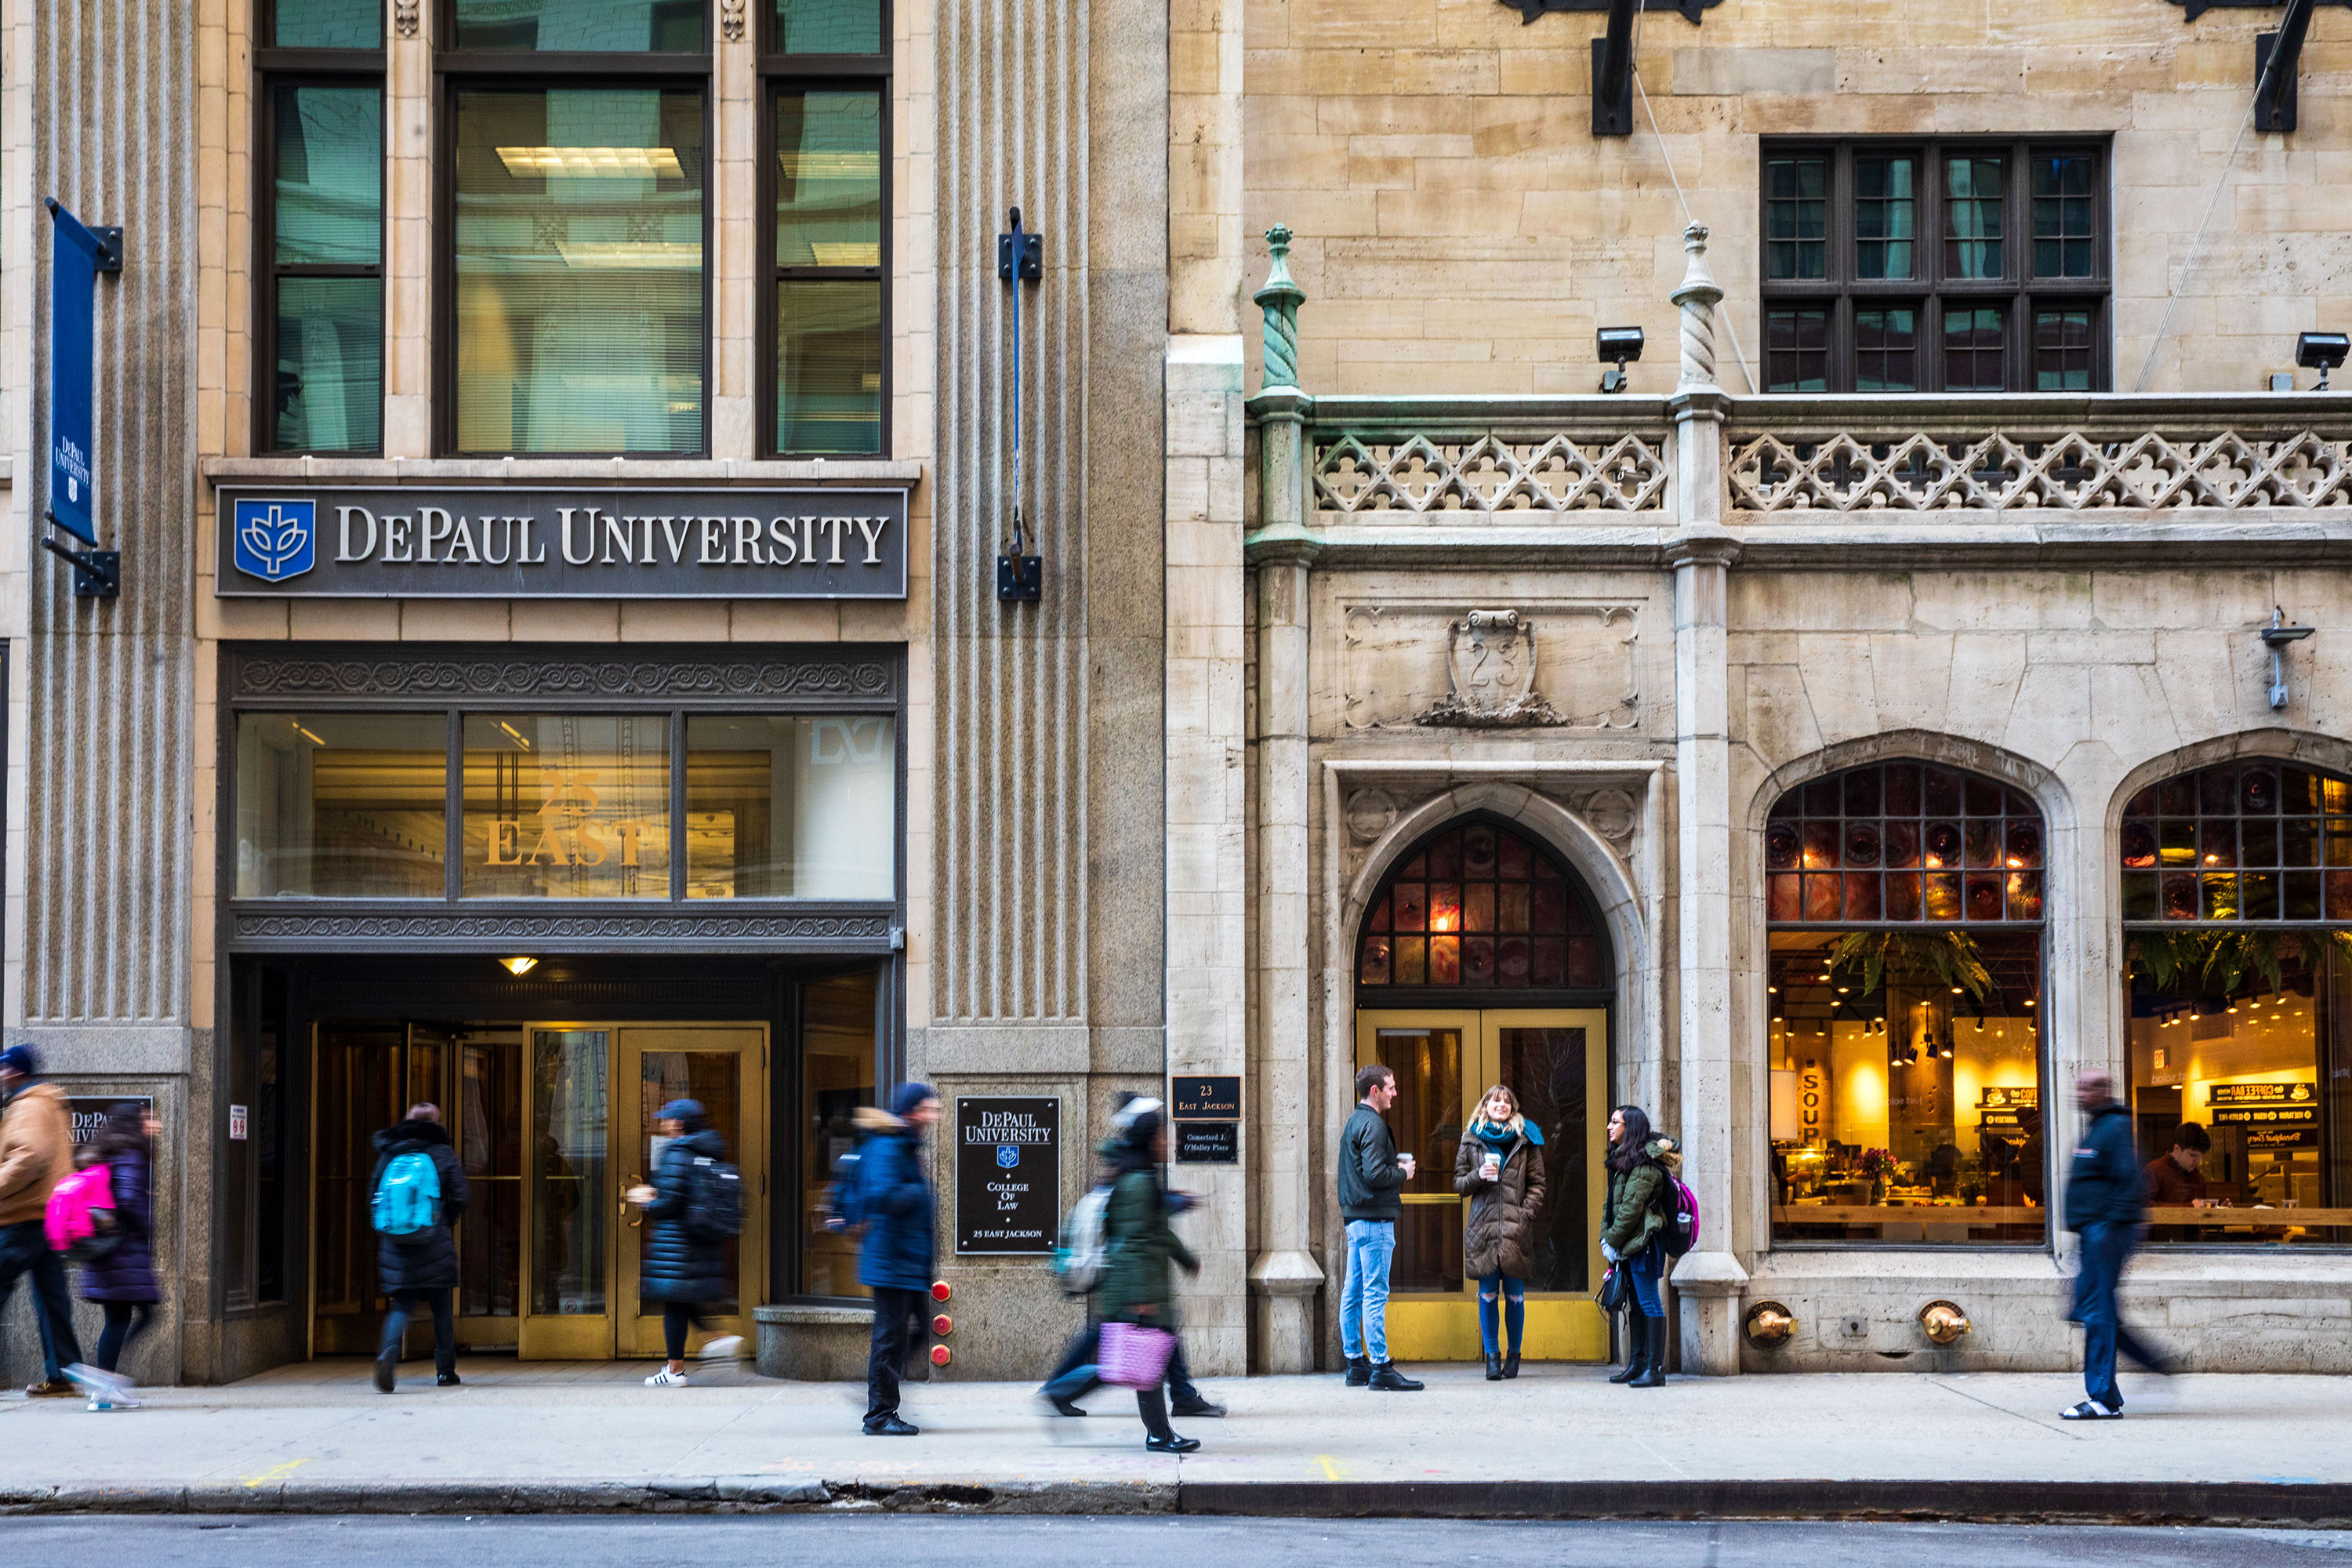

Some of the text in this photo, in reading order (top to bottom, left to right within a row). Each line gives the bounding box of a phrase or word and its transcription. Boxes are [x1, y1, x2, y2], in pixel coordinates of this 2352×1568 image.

[56, 445, 89, 485] UNIVERSITY
[334, 506, 890, 566] DEPAUL UNIVERSITY
[1468, 641, 1520, 688] 23
[535, 770, 599, 817] 25
[483, 820, 651, 866] EAST
[1200, 1085, 1213, 1097] 23
[1178, 1101, 1235, 1111] EAST JACKSON
[1803, 1075, 1819, 1143] SOUP
[981, 1111, 1036, 1127] DEPAUL
[965, 1126, 1051, 1142] UNIVERSITY
[986, 1181, 1029, 1192] COLLEGE
[1000, 1191, 1016, 1201] OF
[996, 1201, 1019, 1210] LAW
[1004, 1230, 1043, 1239] JACKSON
